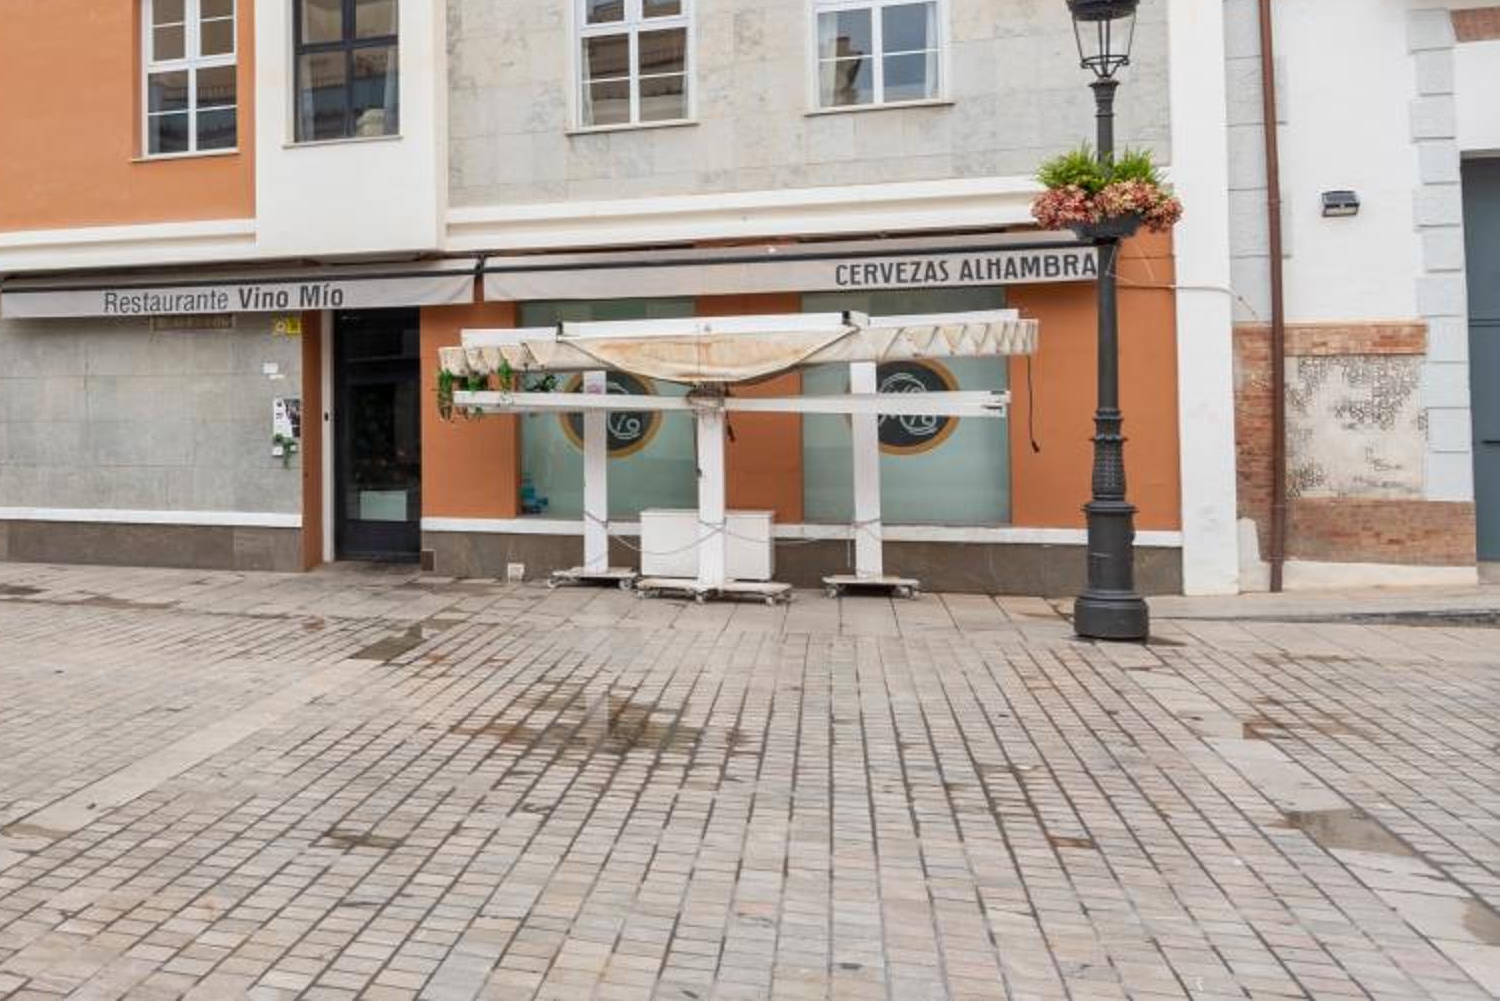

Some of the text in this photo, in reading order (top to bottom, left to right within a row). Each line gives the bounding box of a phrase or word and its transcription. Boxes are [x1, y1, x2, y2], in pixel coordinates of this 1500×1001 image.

[835, 252, 1098, 286] CERVEZAS ALHAMBRA
[103, 283, 344, 314] Restaurante Vino Mío
